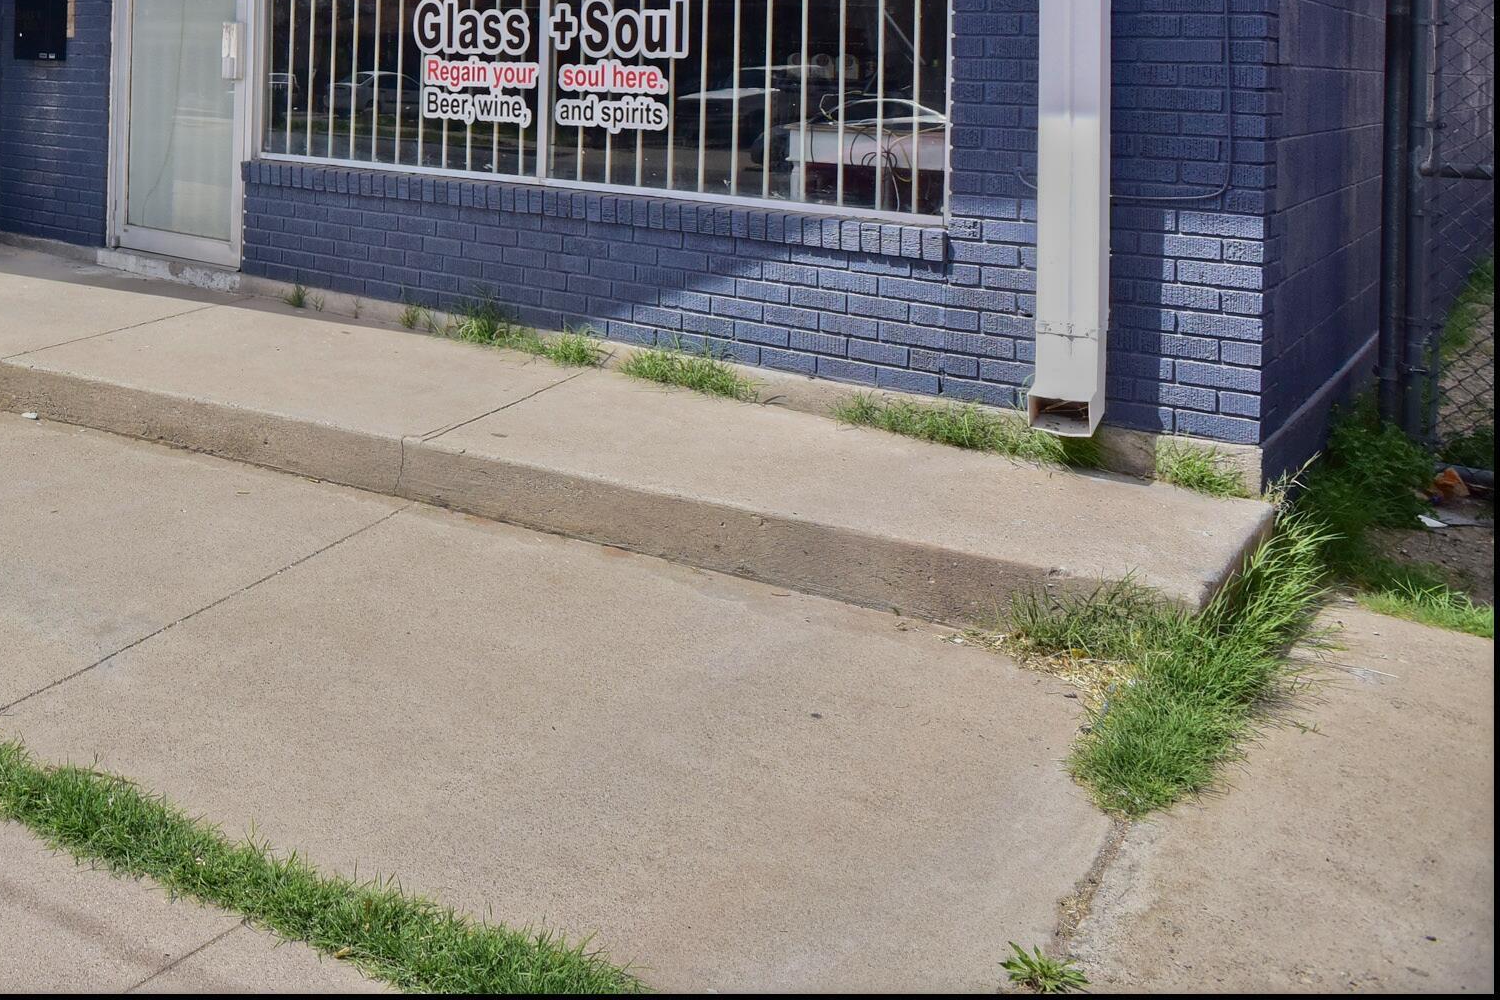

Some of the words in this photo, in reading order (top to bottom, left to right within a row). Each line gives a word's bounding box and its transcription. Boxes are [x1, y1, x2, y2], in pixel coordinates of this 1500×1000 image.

[416, 0, 527, 52] Glass
[427, 58, 488, 88] Regain
[492, 65, 536, 89] your
[562, 64, 606, 89] soul
[611, 64, 665, 90] here.
[426, 91, 472, 120] Beer,
[478, 95, 528, 122] wine,
[560, 99, 594, 123] and
[600, 99, 664, 129] spirits
